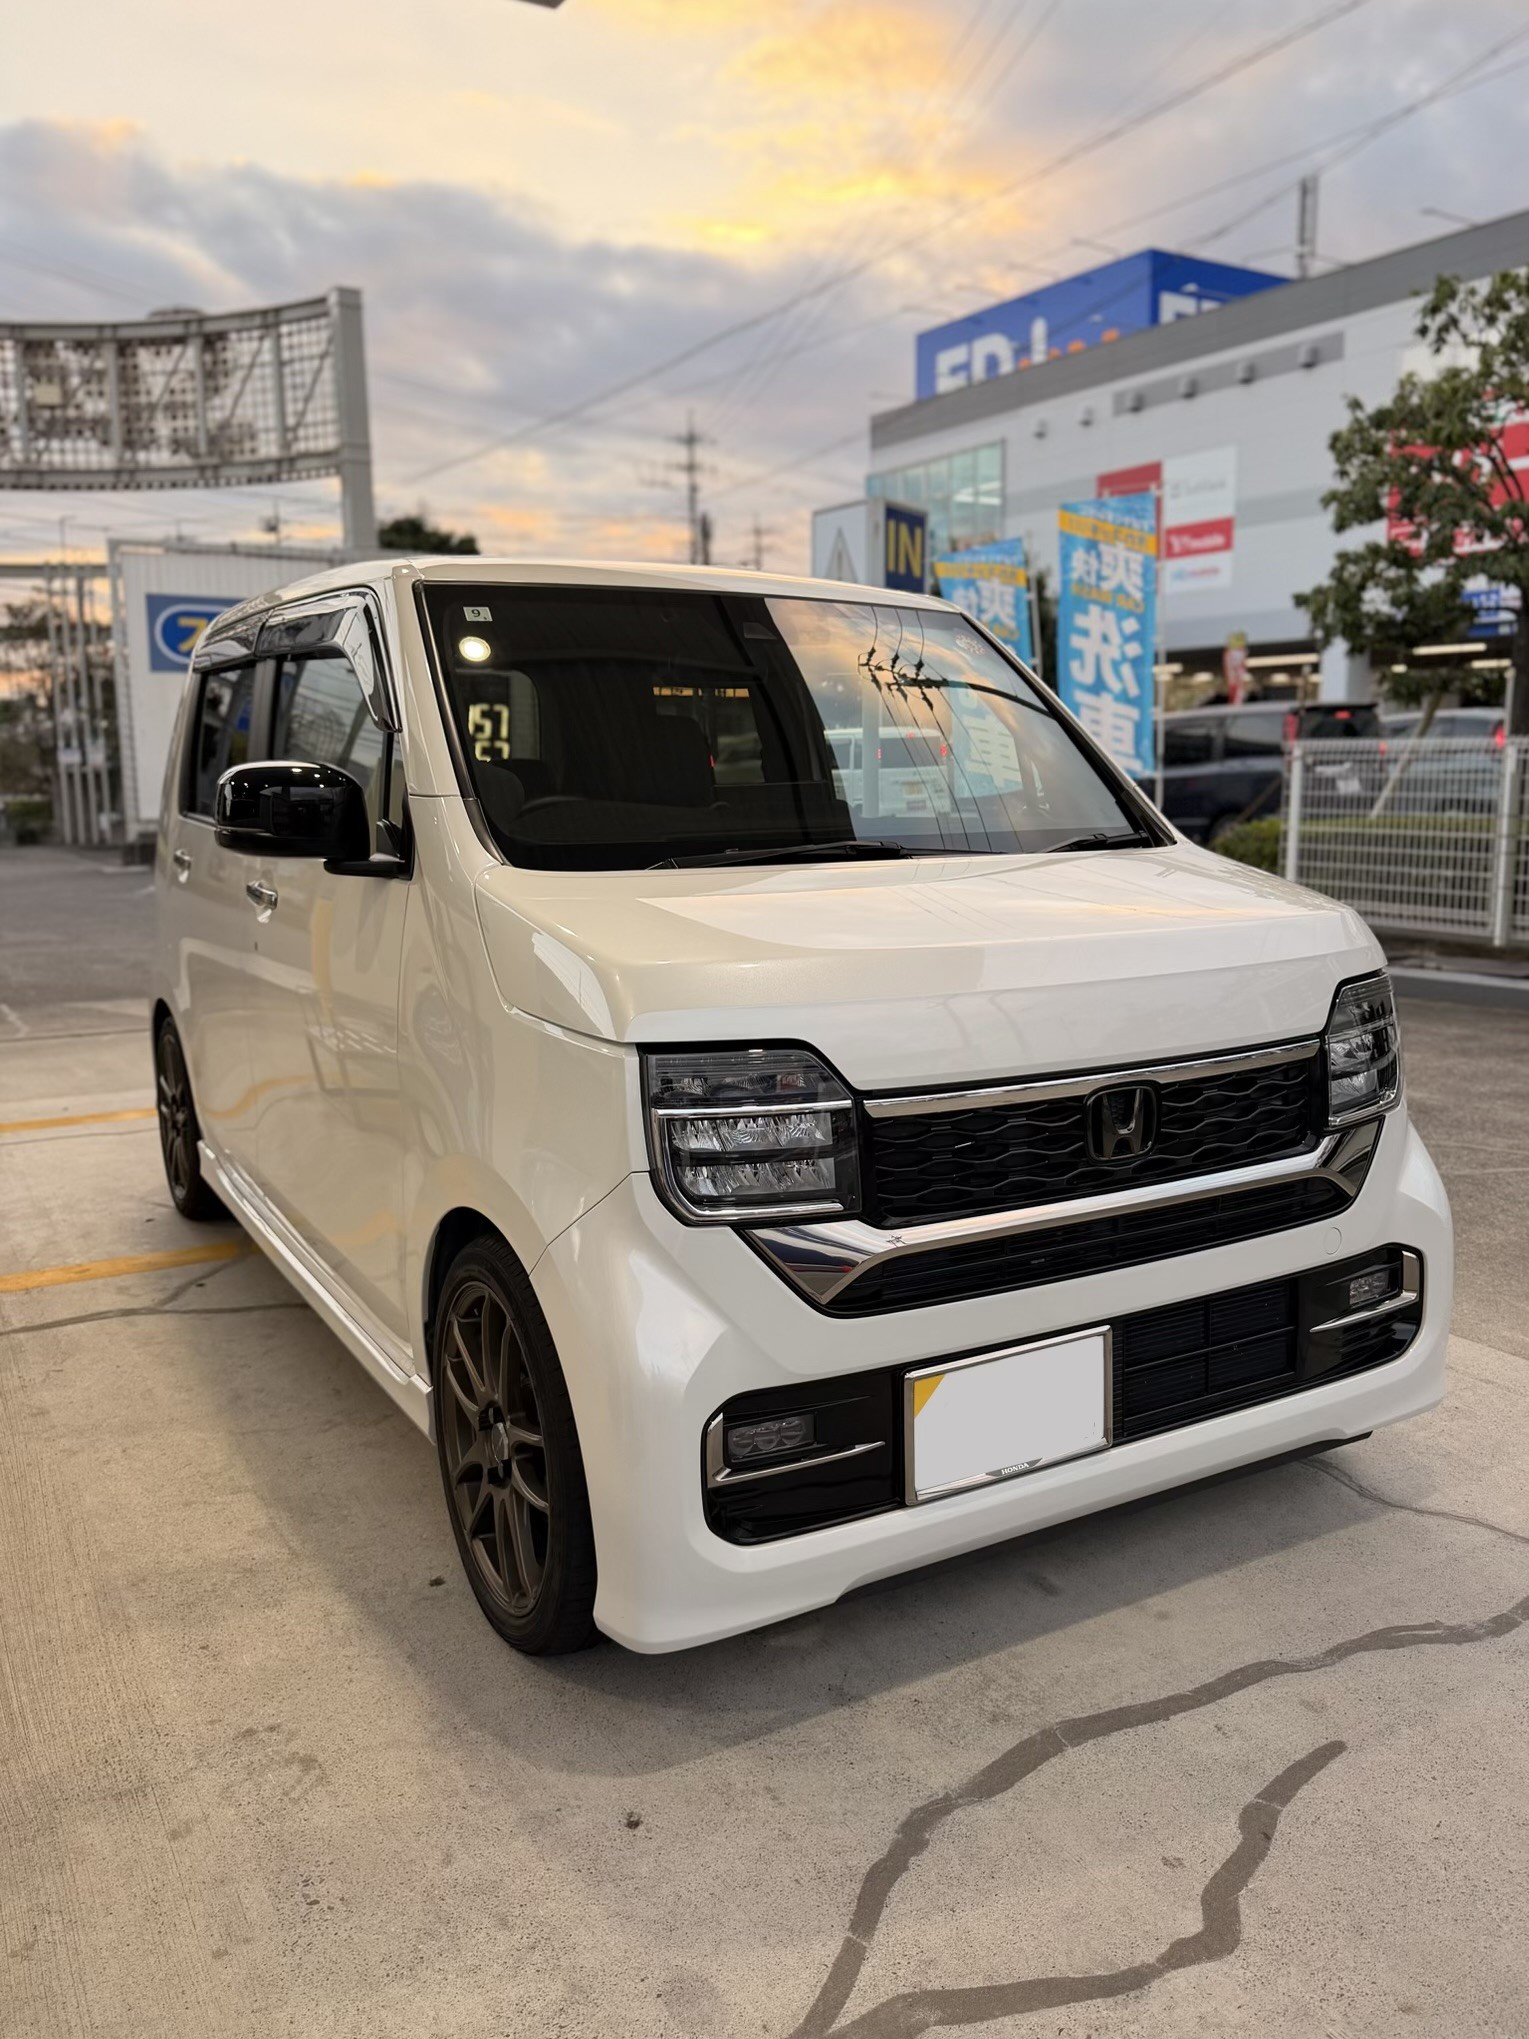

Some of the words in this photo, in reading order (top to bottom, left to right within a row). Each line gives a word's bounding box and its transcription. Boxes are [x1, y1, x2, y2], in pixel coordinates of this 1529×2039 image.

[887, 519, 923, 579] IN
[471, 609, 481, 618] 9
[1001, 1462, 1029, 1475] HONDA
